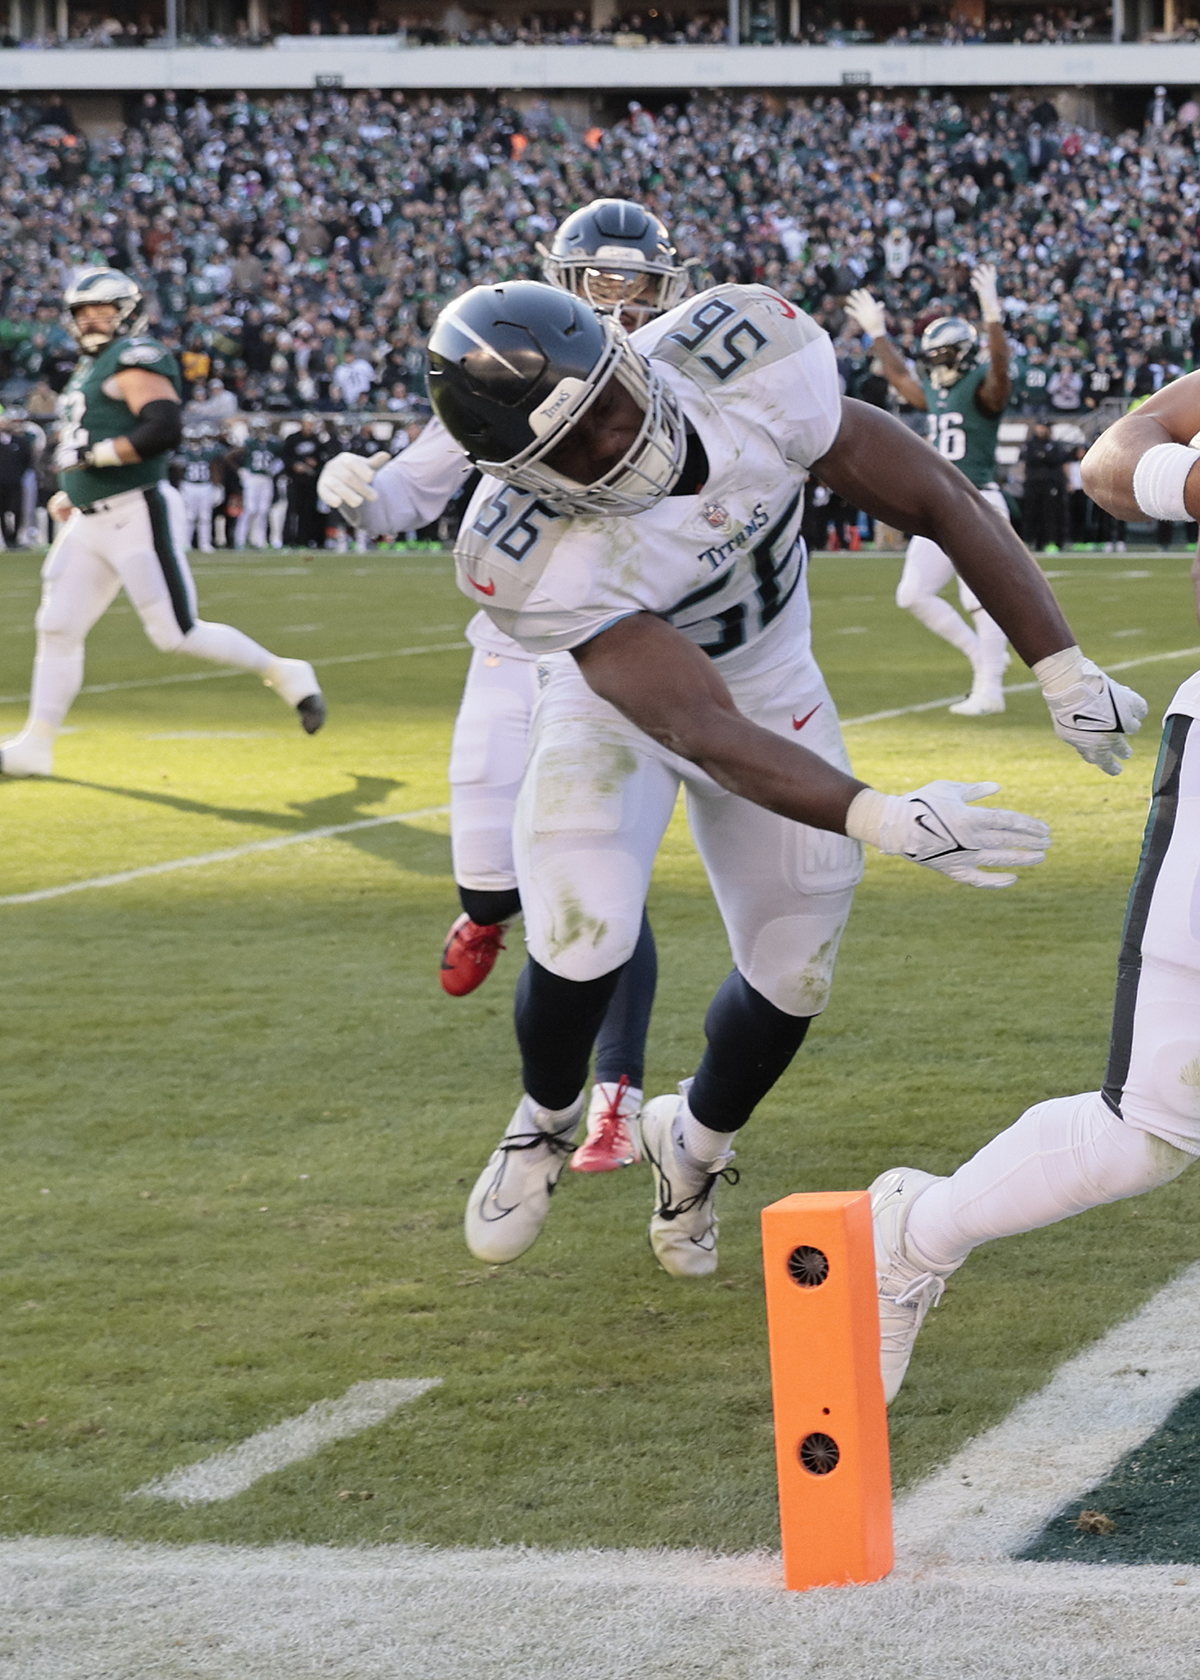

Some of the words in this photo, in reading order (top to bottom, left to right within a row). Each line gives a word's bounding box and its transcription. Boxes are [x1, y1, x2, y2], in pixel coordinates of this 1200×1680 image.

[540, 389, 571, 418] TITANS
[469, 484, 564, 564] 56
[698, 504, 769, 571] TITANS
